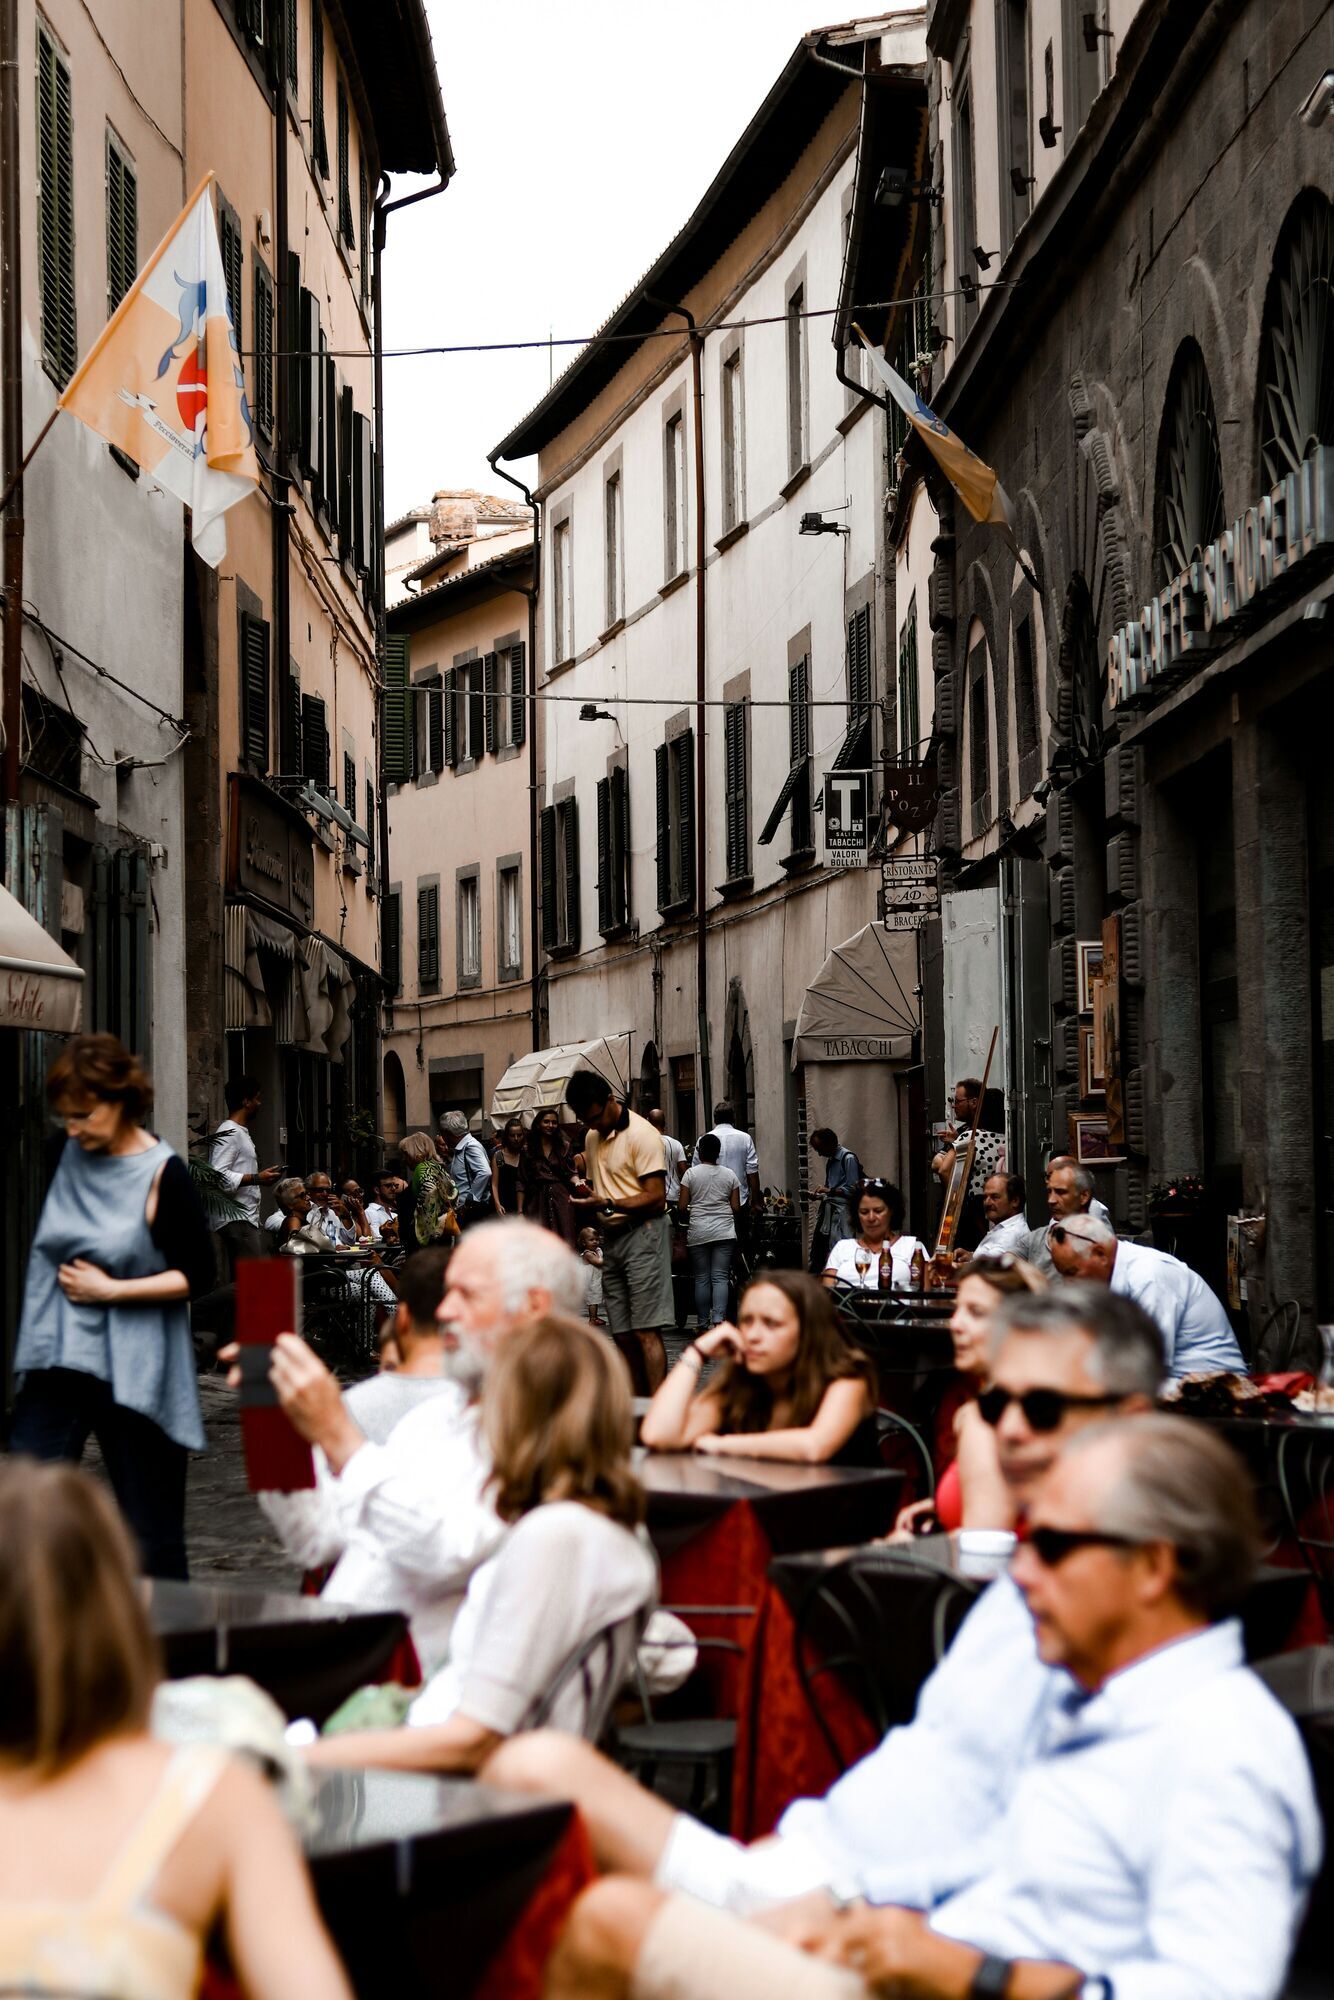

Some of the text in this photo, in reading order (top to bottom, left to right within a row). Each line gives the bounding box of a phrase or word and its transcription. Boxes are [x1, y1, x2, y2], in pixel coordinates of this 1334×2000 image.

[153, 420, 195, 457] Peccioverar
[1108, 621, 1141, 711] BAR
[907, 774, 925, 786] IL
[831, 779, 860, 832] T
[829, 838, 864, 847] TABACCHI
[831, 850, 860, 858] VALORI
[830, 858, 862, 867] BOLLATI
[886, 864, 934, 877] RISTORANTE
[894, 914, 928, 927] BRACE
[823, 1040, 893, 1056] TABACCHI
